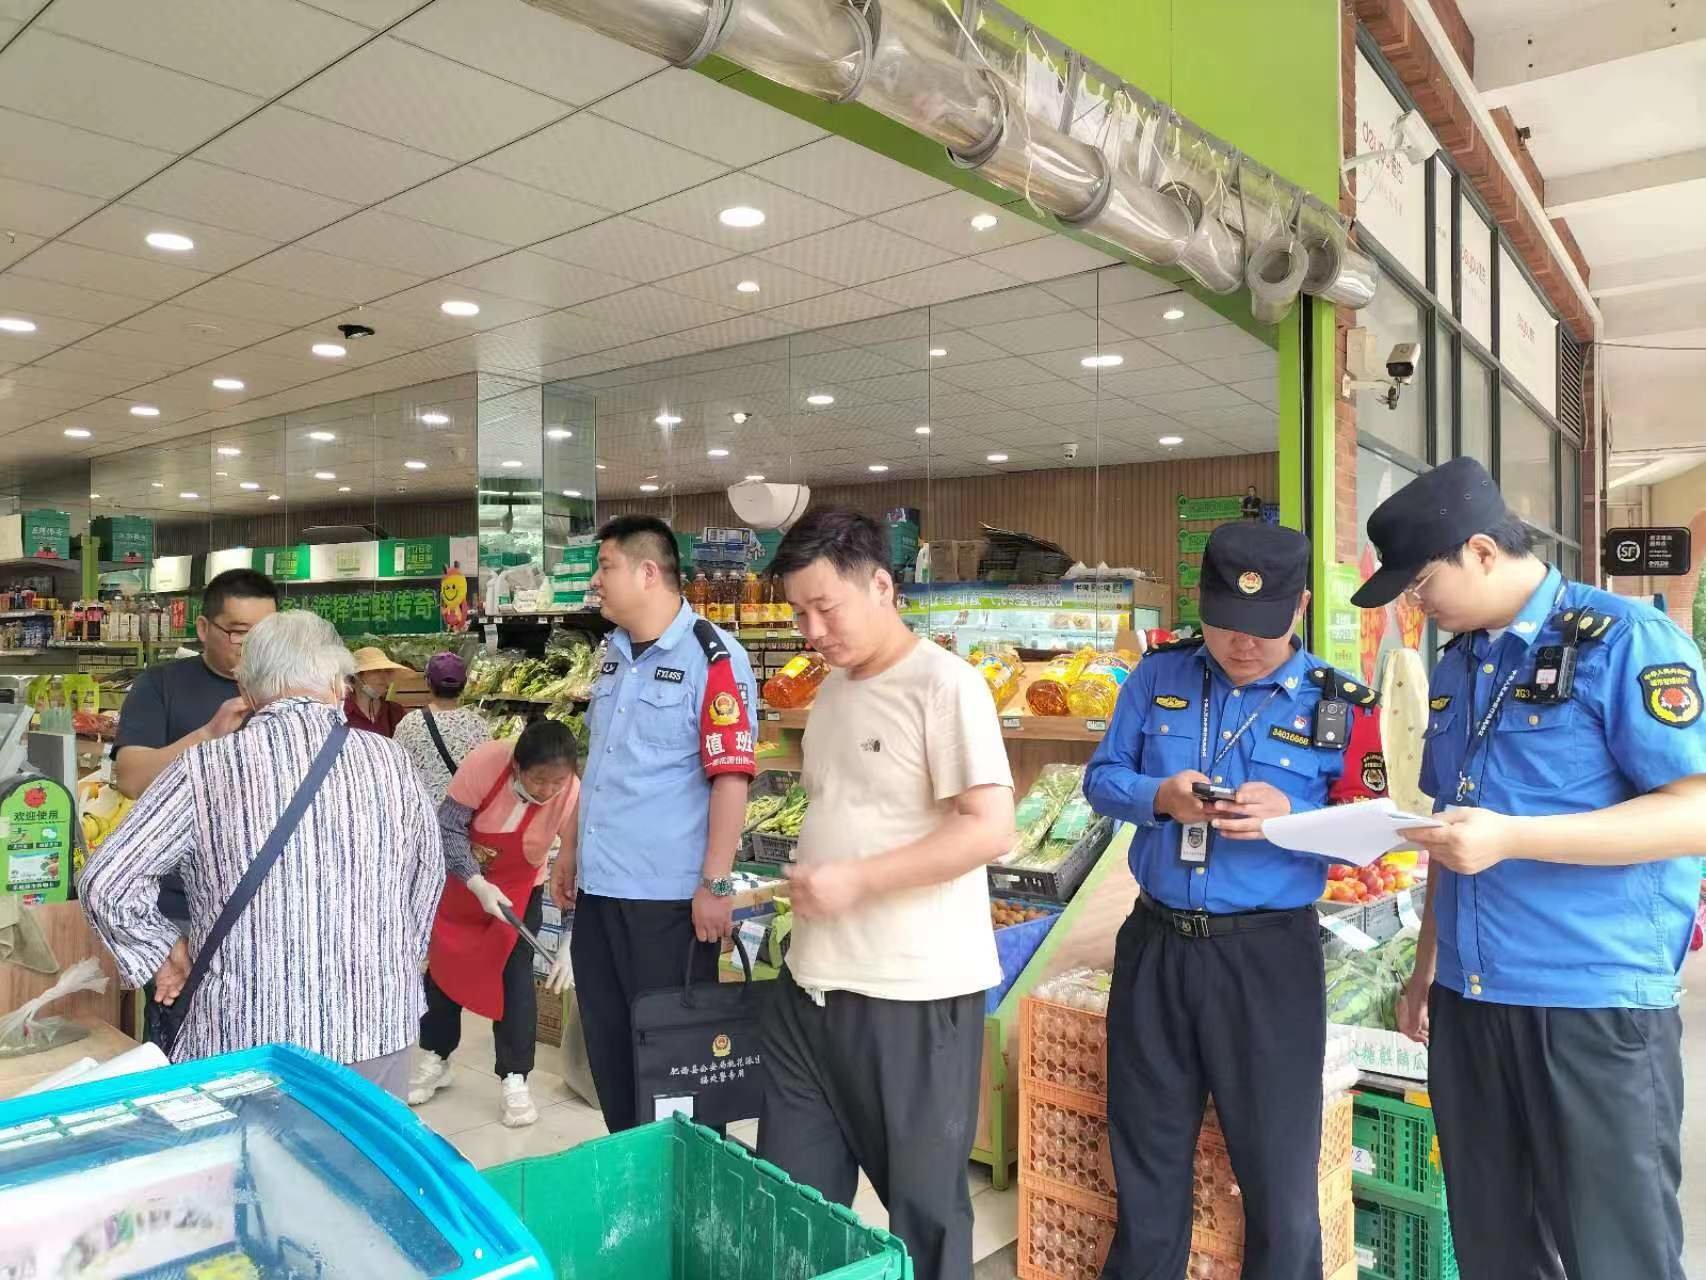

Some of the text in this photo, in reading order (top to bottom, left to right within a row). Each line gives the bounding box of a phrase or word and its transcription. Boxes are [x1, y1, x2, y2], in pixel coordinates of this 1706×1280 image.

[1620, 546, 1636, 557] SF
[279, 588, 436, 624] 选择生鲜传奇
[705, 730, 754, 757] 值班
[13, 809, 59, 822] 欢迎使用
